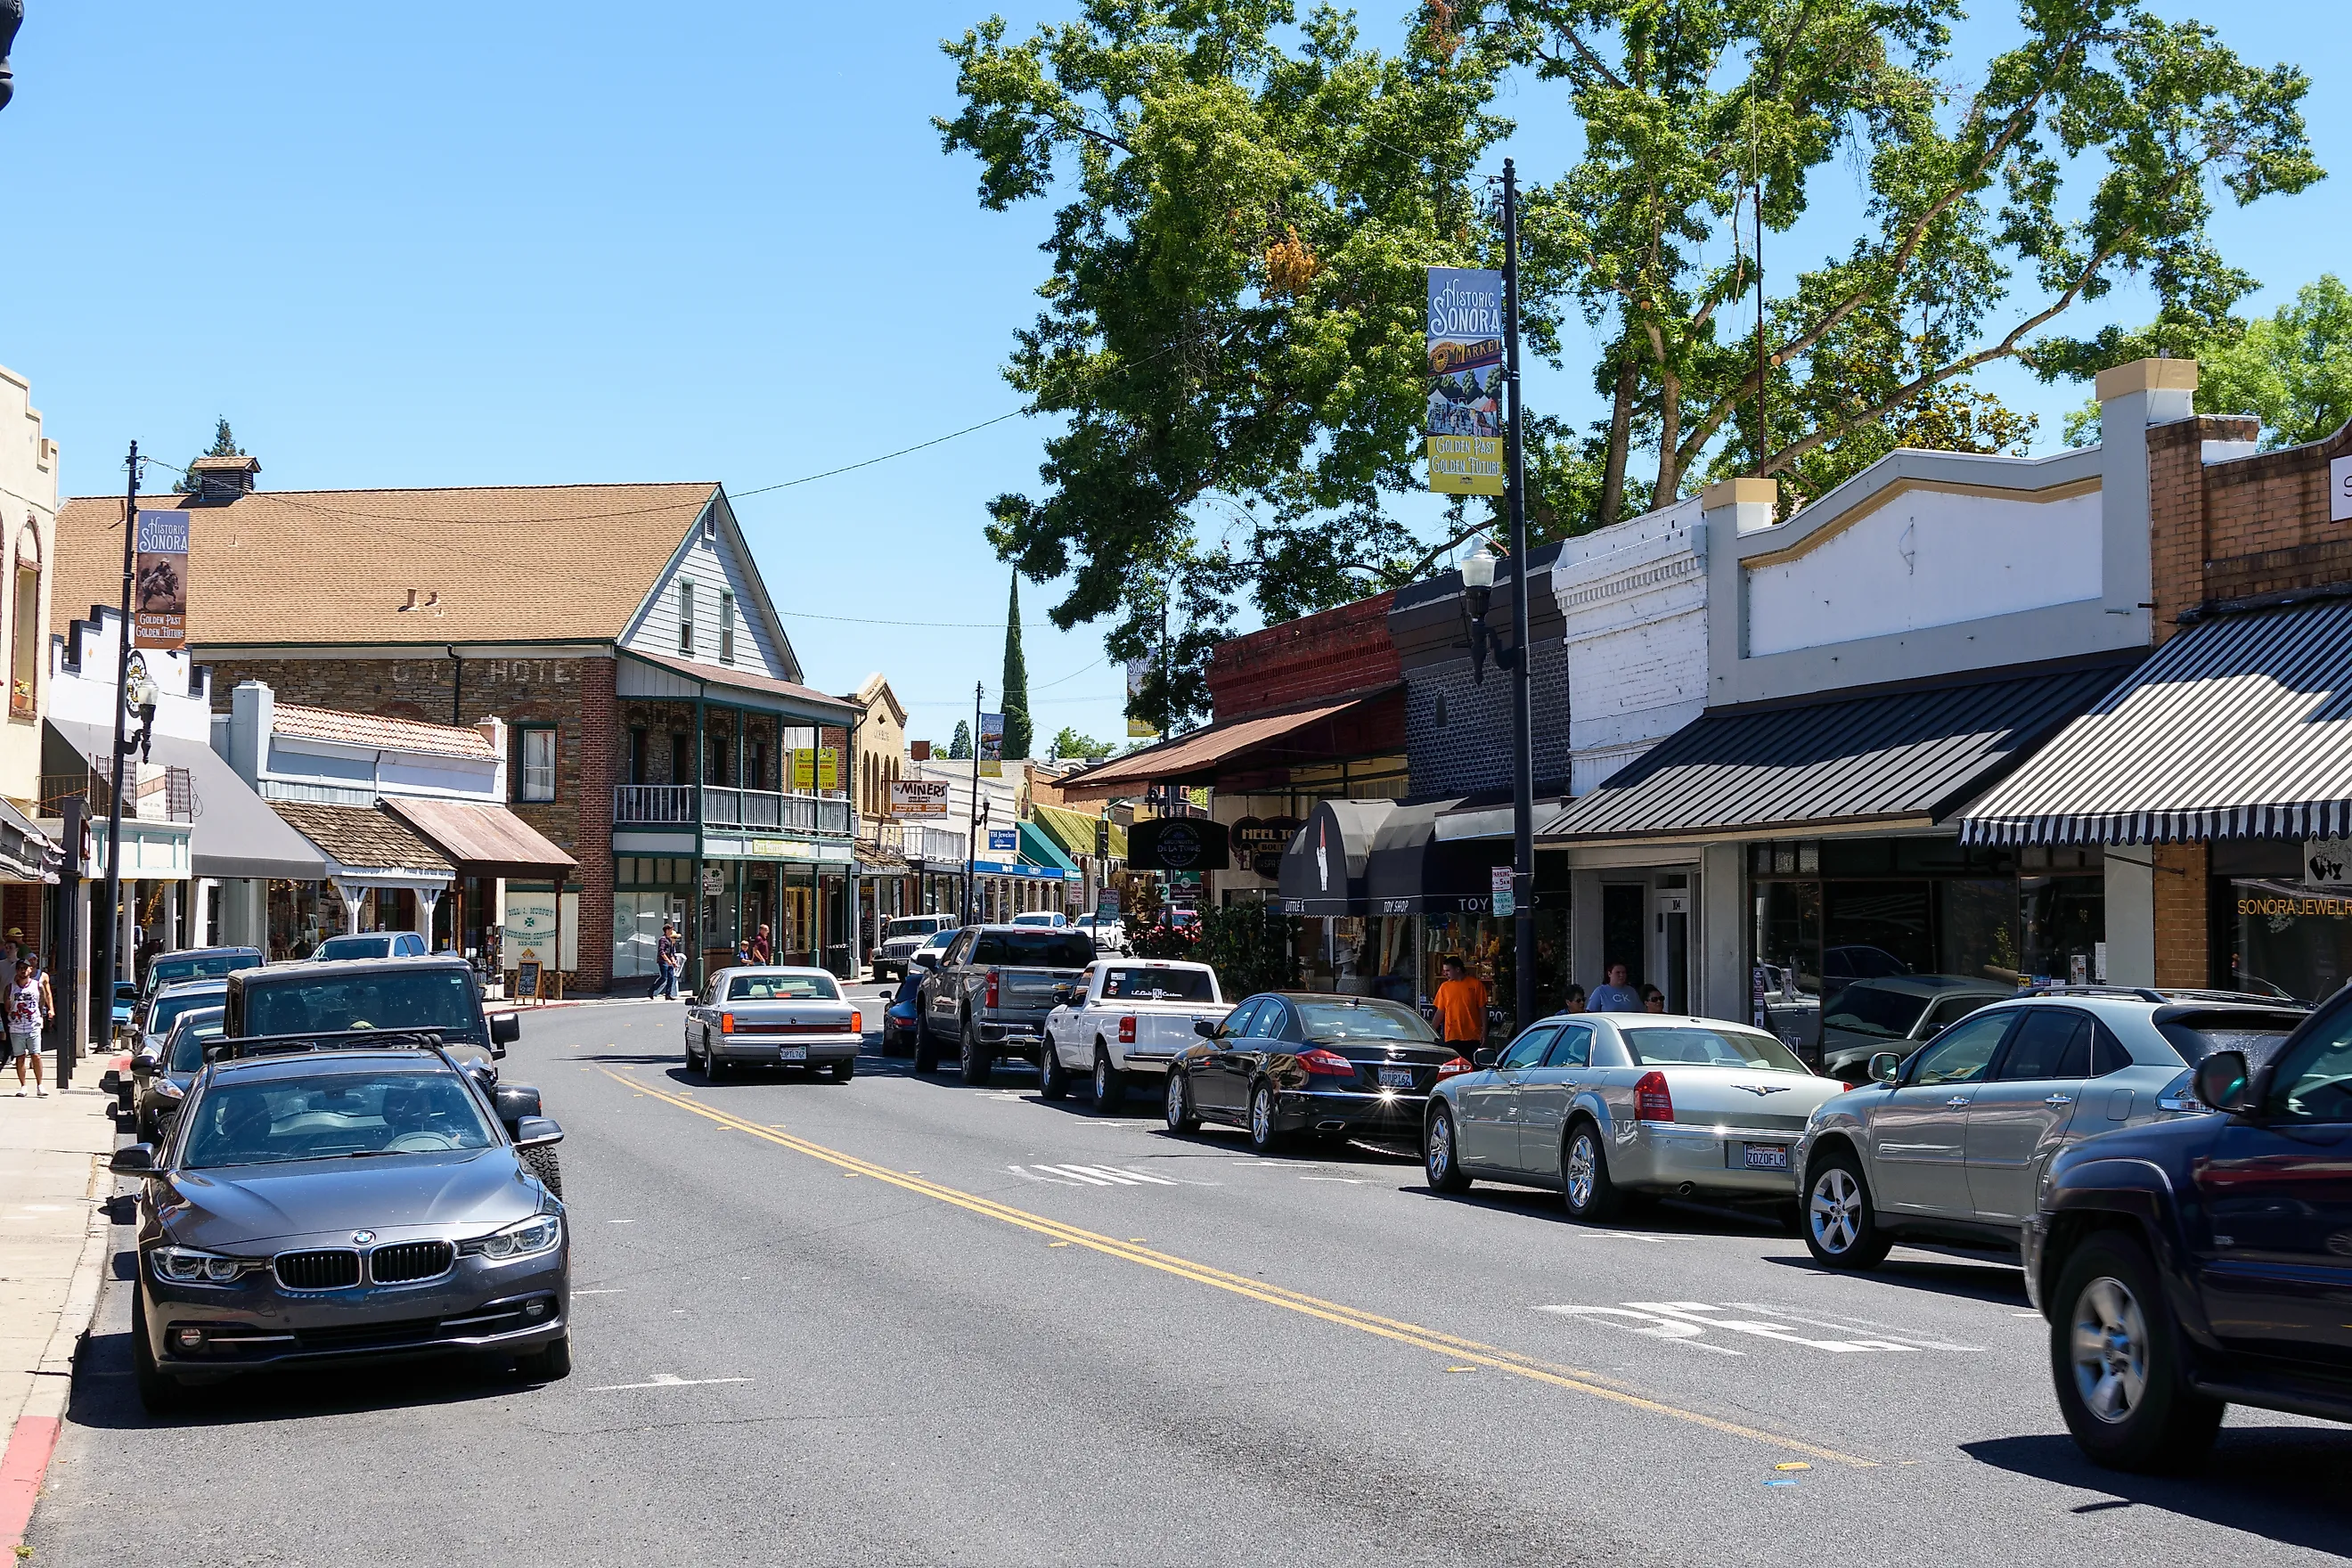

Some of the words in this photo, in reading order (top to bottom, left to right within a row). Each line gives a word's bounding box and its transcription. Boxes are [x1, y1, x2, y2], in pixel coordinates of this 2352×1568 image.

[1430, 296, 1500, 337] SONORA
[1435, 437, 1470, 454] GOLDEN
[1473, 437, 1496, 455] PAST
[1431, 455, 1466, 473] GOLDEN
[1469, 457, 1500, 475] FUTURE
[139, 527, 188, 552] SONORA
[166, 615, 181, 625] PAST
[900, 783, 946, 797] MINERS
[1242, 829, 1277, 840] HEEL
[1285, 900, 1301, 912] LITTLE
[1384, 901, 1393, 912] TOY
[1393, 901, 1409, 911] SHOP
[1458, 898, 1489, 911] TOY
[1672, 899, 1681, 910] 104
[2237, 899, 2296, 915] SONORA
[1612, 993, 1631, 1002] CK
